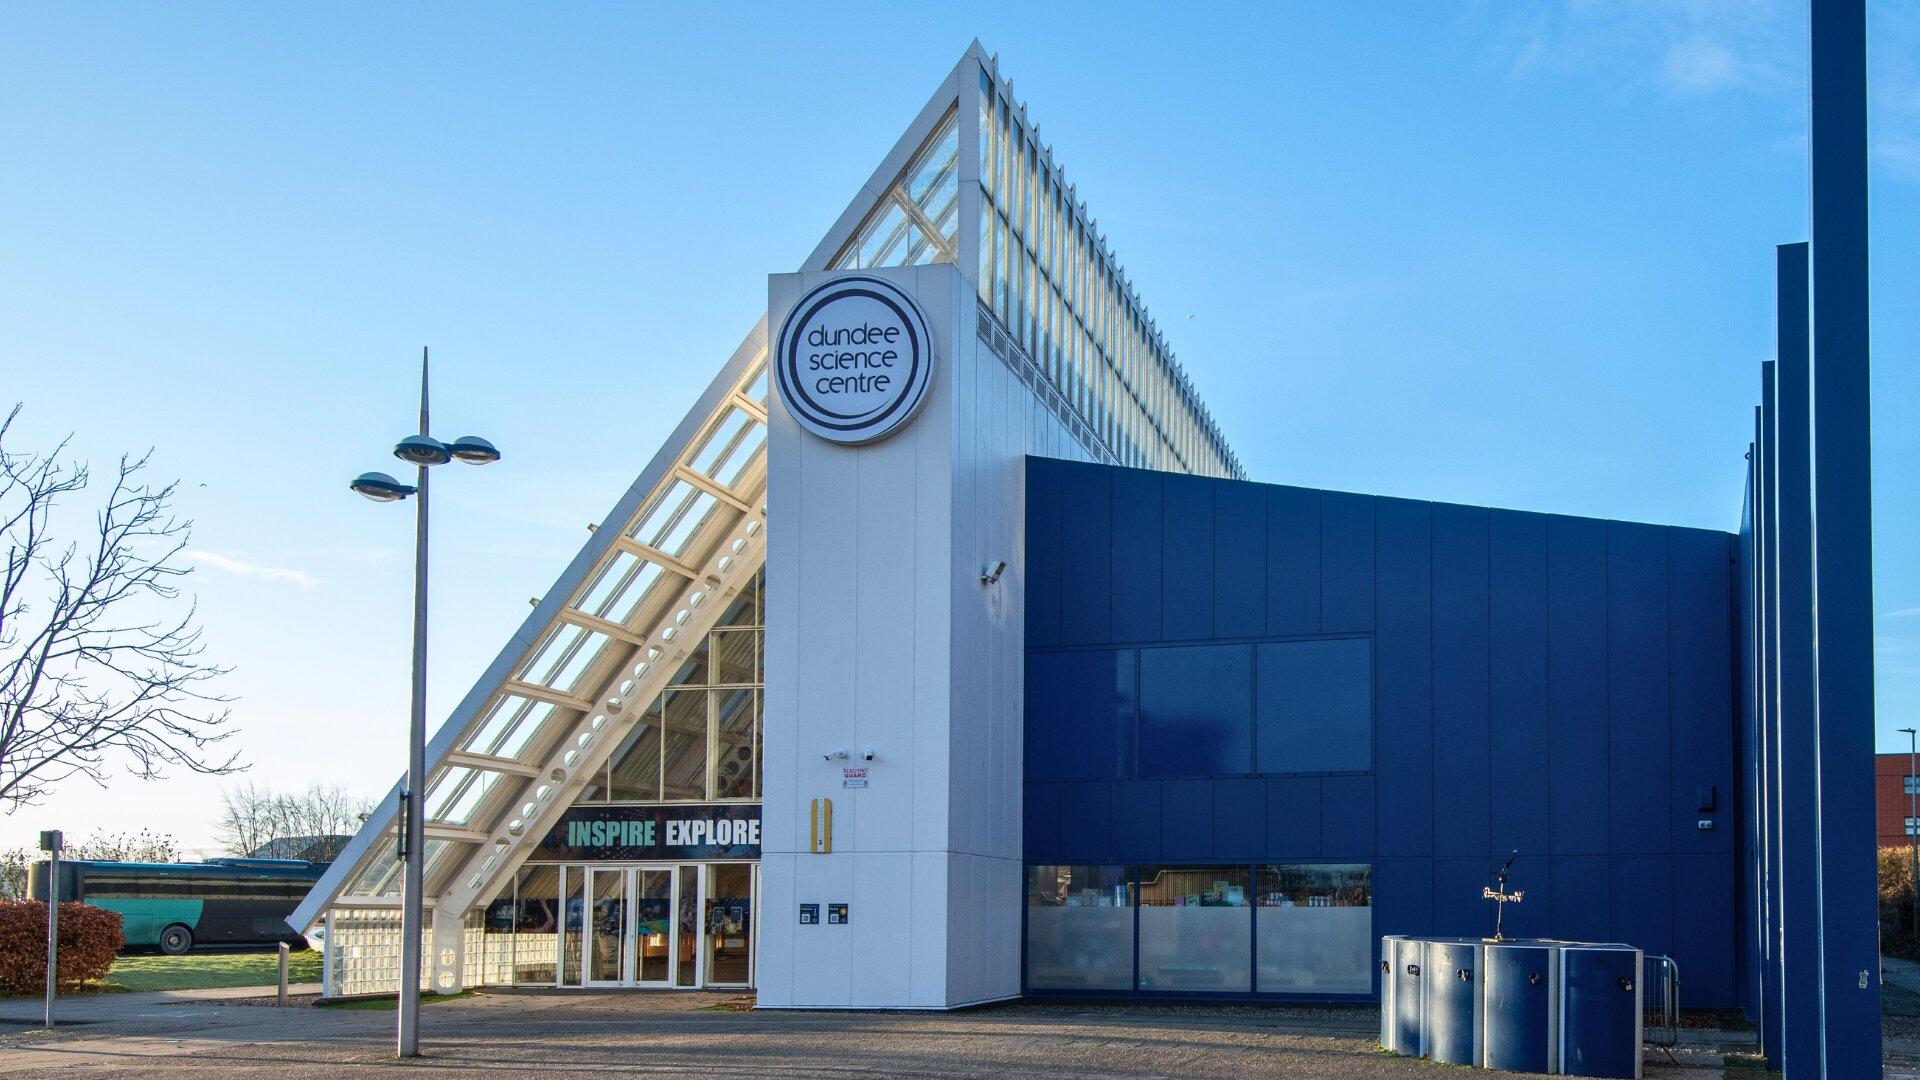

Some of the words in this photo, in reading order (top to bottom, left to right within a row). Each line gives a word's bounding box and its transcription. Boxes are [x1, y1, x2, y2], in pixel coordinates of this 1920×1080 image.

[808, 322, 900, 347] dundee
[809, 350, 898, 371] science
[816, 372, 891, 395] centre
[568, 820, 656, 847] INSPIRE
[666, 819, 760, 846] EXPLORE
